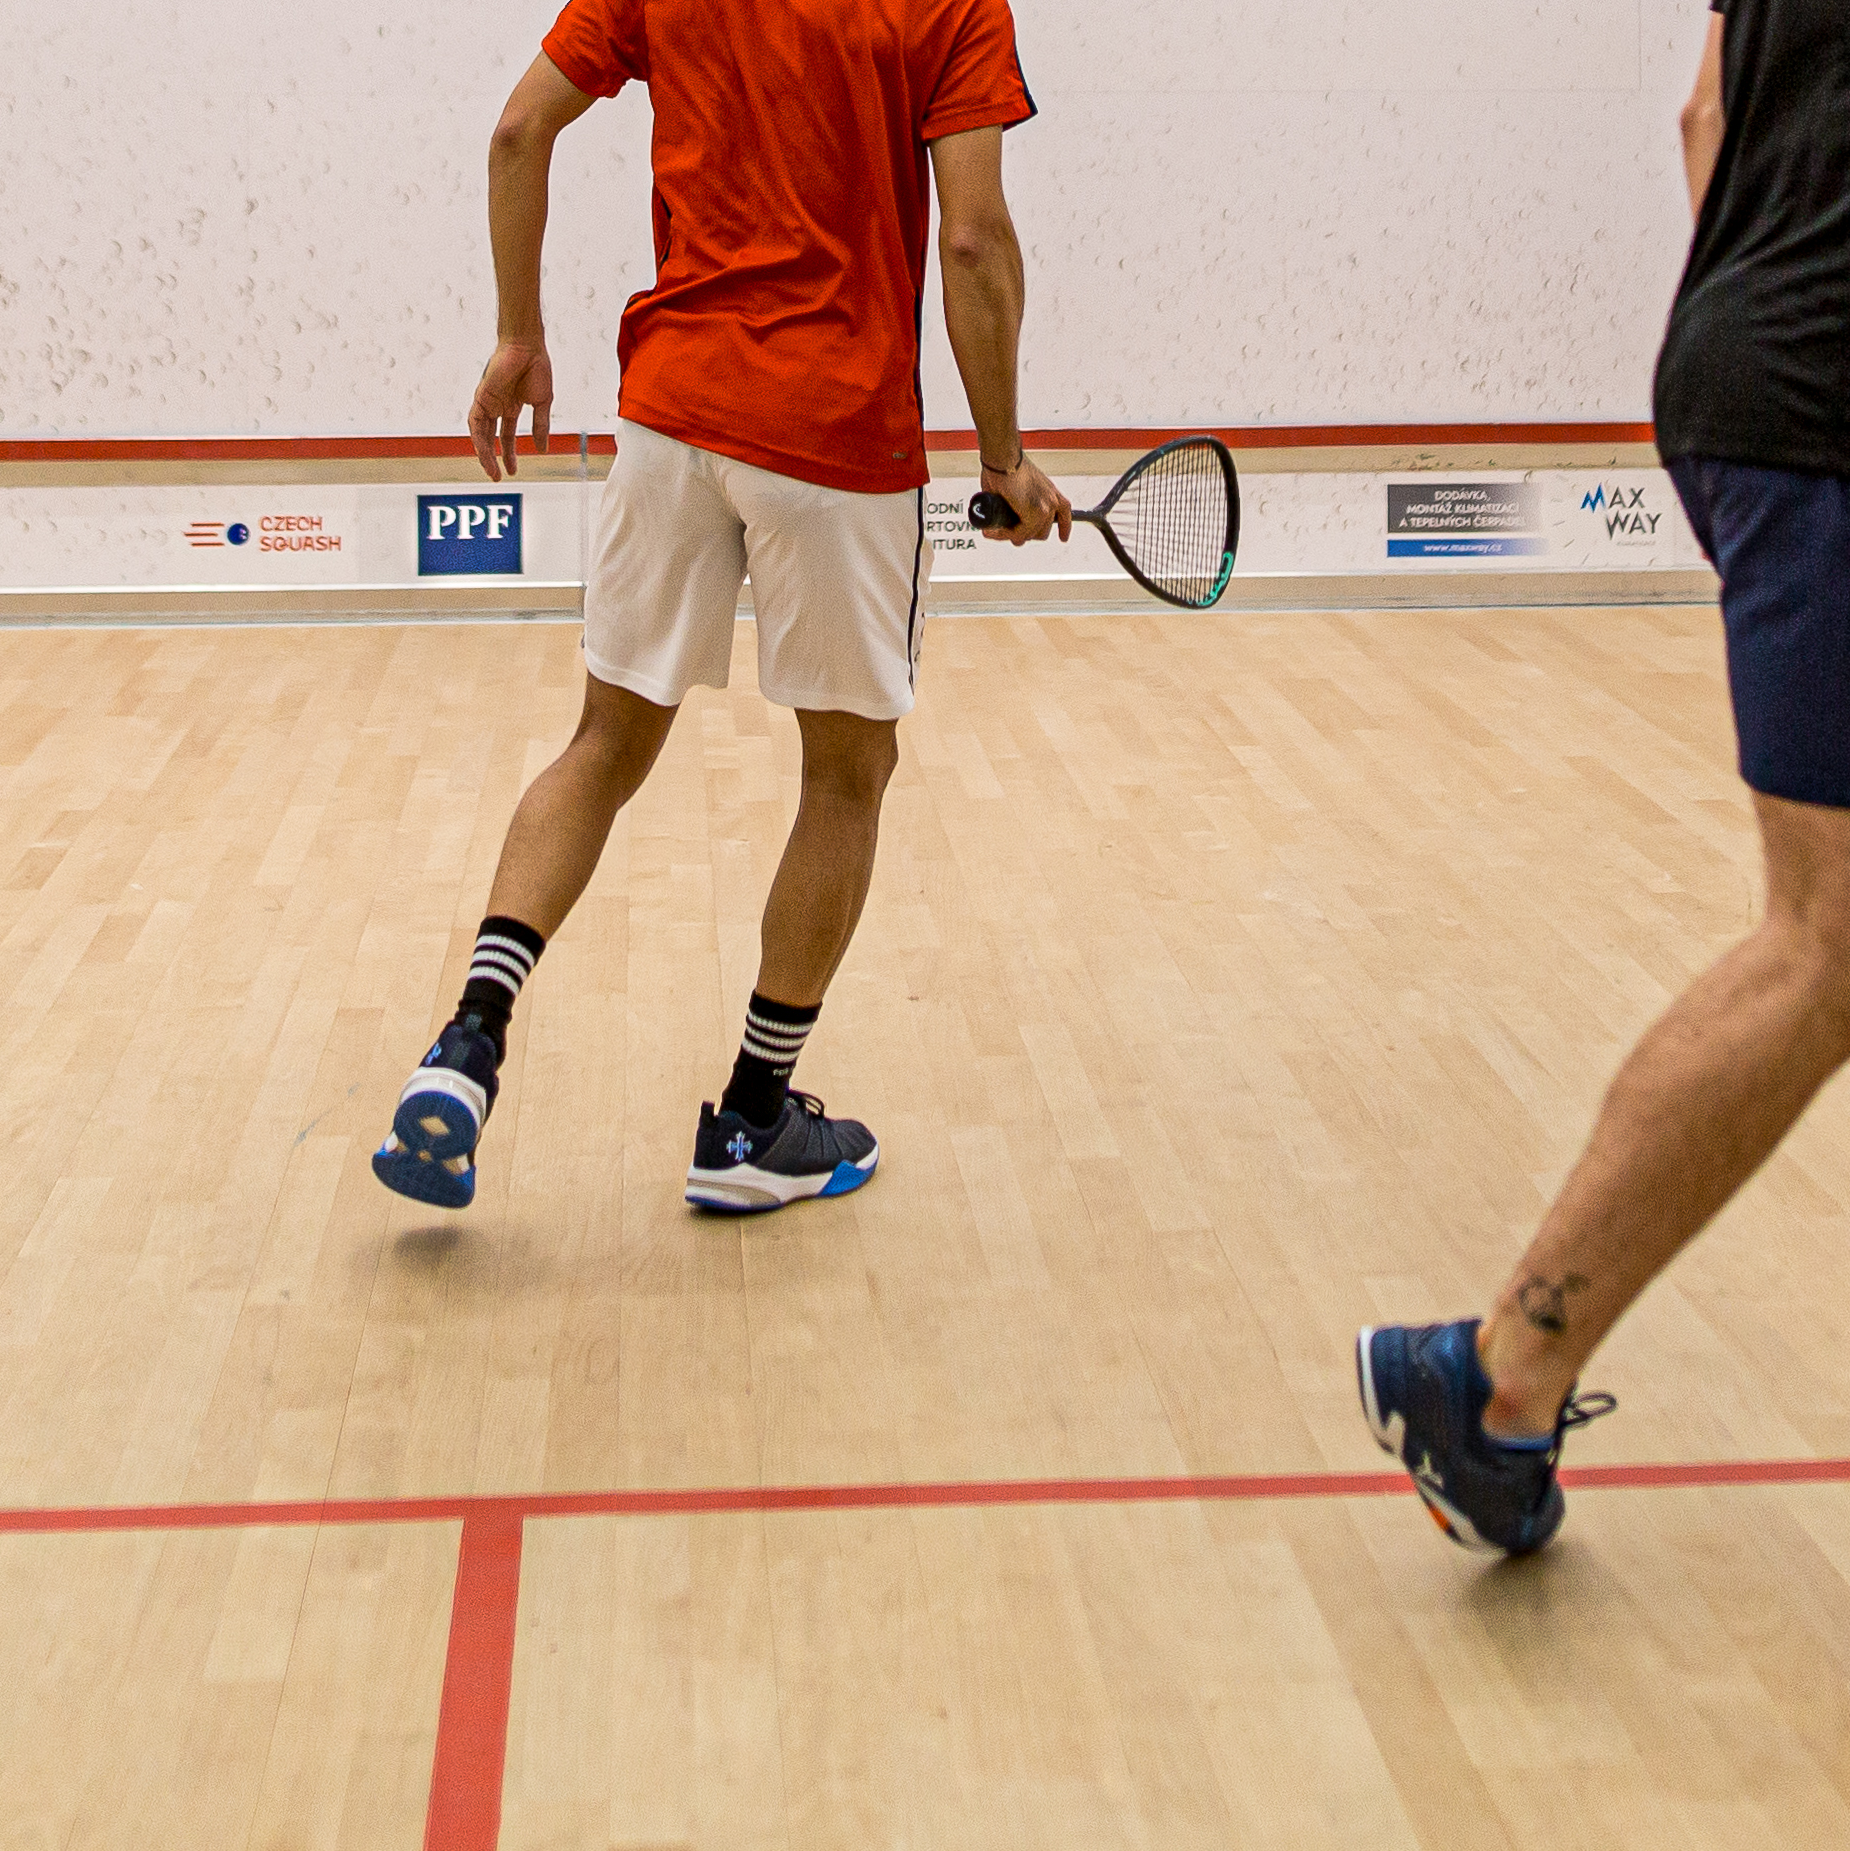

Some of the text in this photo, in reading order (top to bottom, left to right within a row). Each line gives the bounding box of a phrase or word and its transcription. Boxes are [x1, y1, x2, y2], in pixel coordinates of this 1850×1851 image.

[927, 498, 964, 515] ODNÍ
[1580, 482, 1646, 513] MAX
[259, 516, 323, 532] CZECH
[426, 504, 514, 540] PPF
[1606, 510, 1663, 540] WAY
[259, 535, 342, 552] SQUASH
